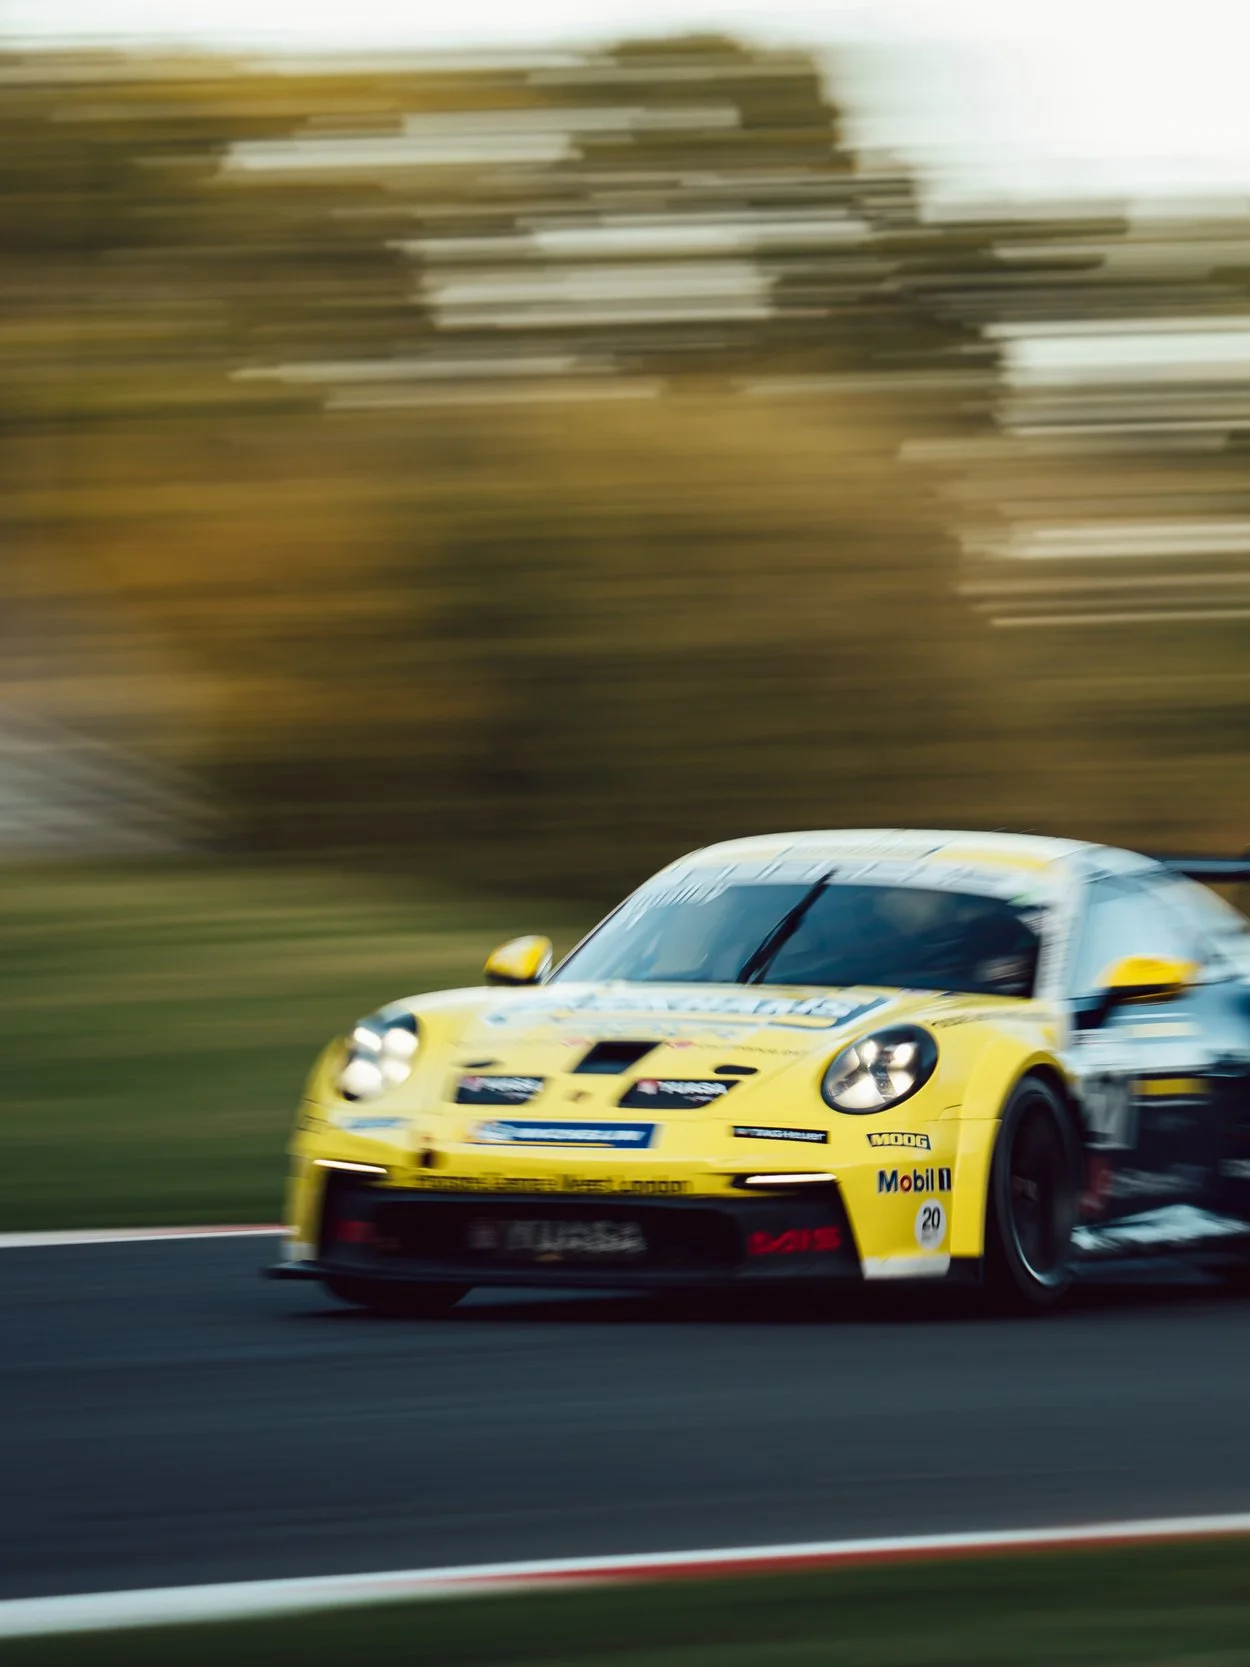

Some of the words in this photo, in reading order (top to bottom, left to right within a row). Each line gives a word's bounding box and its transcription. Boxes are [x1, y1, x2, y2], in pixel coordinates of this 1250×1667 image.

[870, 1132, 929, 1149] MOOG
[878, 1168, 935, 1193] Mobil
[921, 1206, 941, 1231] 20
